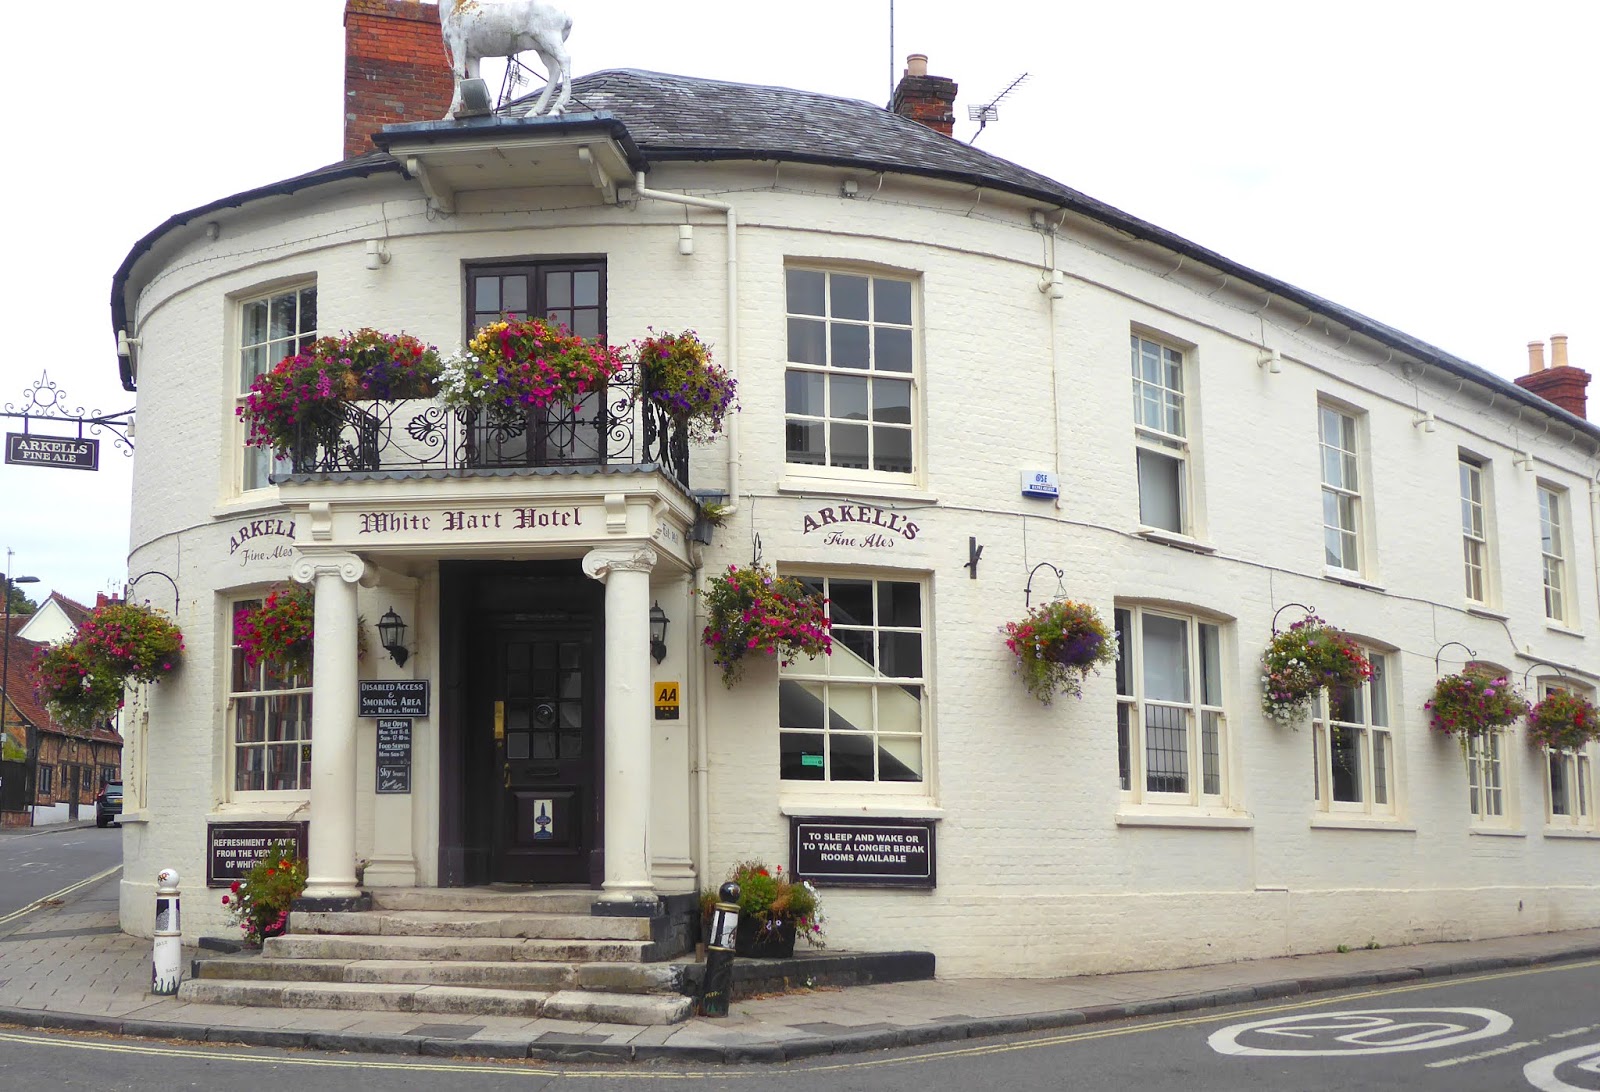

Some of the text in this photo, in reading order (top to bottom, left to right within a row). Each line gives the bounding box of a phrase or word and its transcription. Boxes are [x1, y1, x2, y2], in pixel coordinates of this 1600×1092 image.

[18, 440, 88, 454] ARKELLS
[22, 450, 77, 463] FINE ALE
[358, 507, 583, 535] White Hart Hotel
[803, 505, 920, 540] ARKELL'S
[823, 531, 894, 548] Fine Ales
[240, 545, 293, 567] Fine Ales
[361, 683, 424, 691] DISABLED ACCESS
[658, 688, 677, 702] AA
[362, 697, 421, 706] SMOKING AREA
[213, 838, 265, 847] REFRESHMENT
[267, 838, 273, 847] &
[808, 832, 919, 843] TO SLEEP AND WAKE OR
[216, 849, 236, 858] FROM
[237, 849, 252, 858] THE
[802, 842, 925, 854] TO TAKE A LONGER BREAK
[820, 853, 907, 863] ROOMS AVAILABLE
[225, 860, 236, 869] OF
